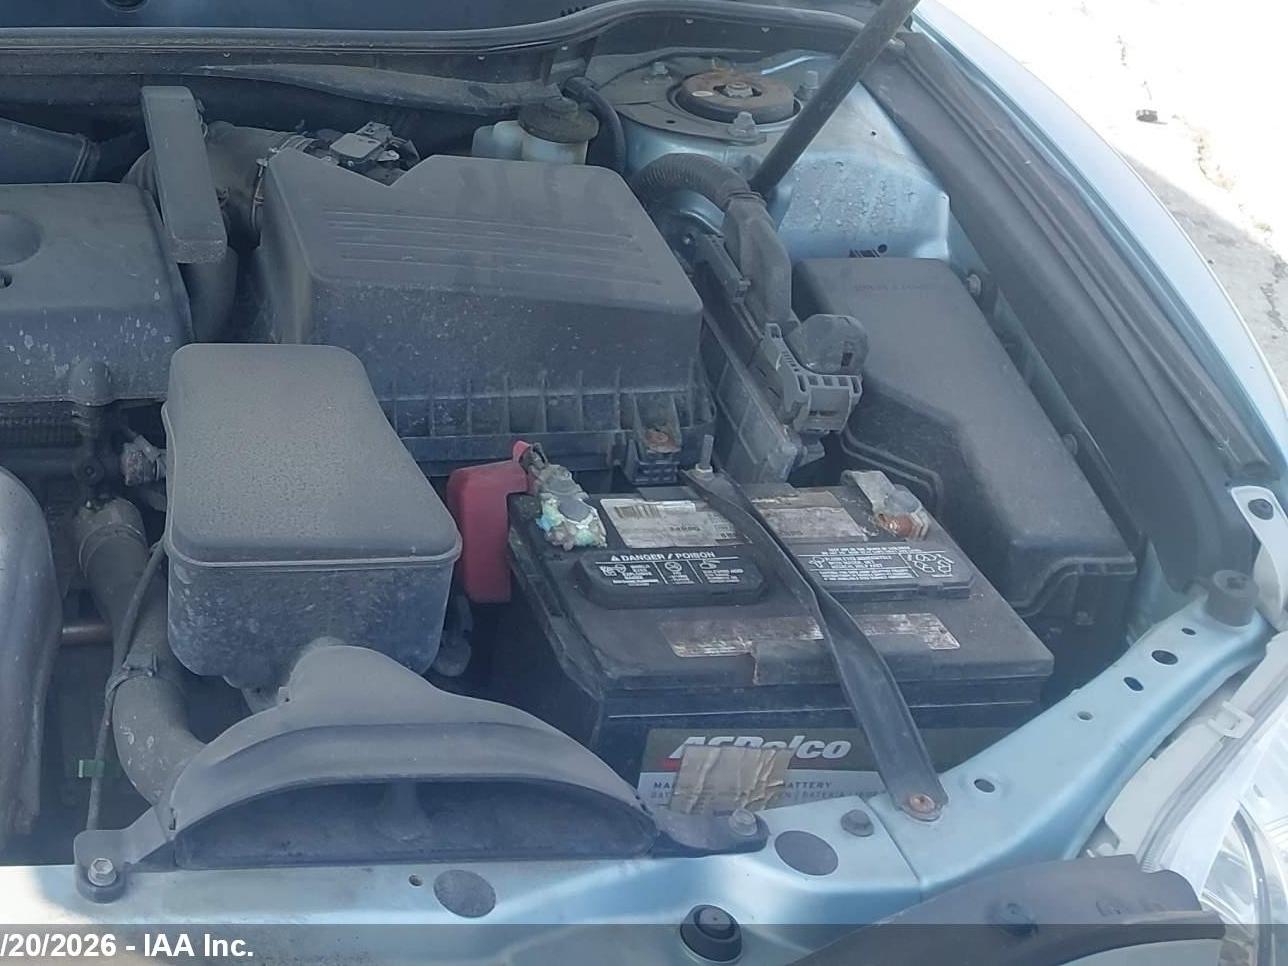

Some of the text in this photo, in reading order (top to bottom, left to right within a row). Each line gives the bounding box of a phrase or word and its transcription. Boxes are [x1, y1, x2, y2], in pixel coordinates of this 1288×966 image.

[620, 553, 666, 562] DANGER
[676, 551, 717, 559] POISON
[787, 781, 832, 789] ATTERY
